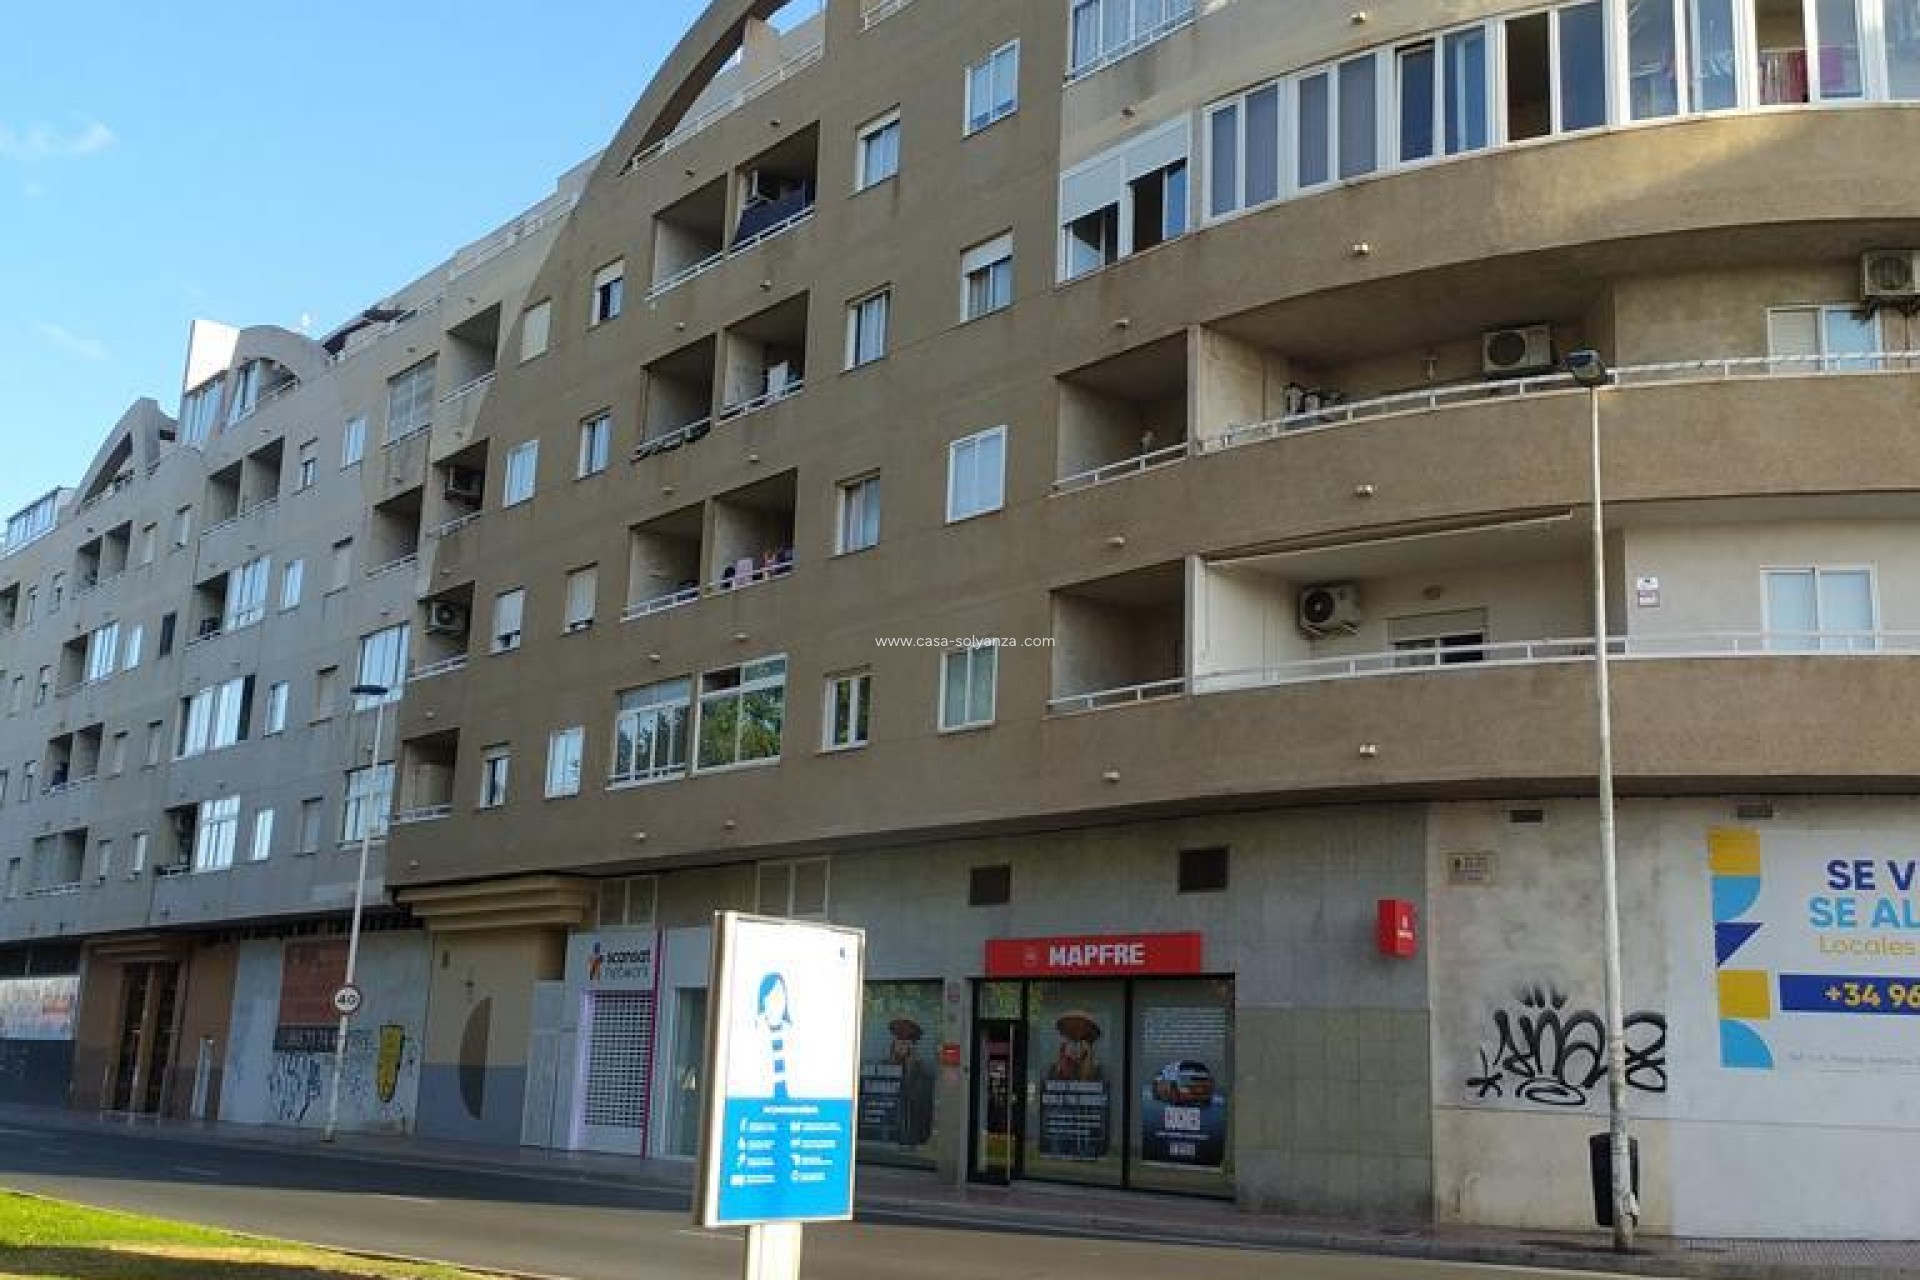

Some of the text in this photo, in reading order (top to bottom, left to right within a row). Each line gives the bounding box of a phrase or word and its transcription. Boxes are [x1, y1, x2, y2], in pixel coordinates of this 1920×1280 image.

[1827, 860, 1876, 890] SE
[1809, 897, 1858, 928] SE
[1049, 943, 1146, 966] MAPFRE
[1818, 934, 1916, 956] Locales
[338, 993, 358, 1006] 40
[1824, 982, 1880, 1007] +34
